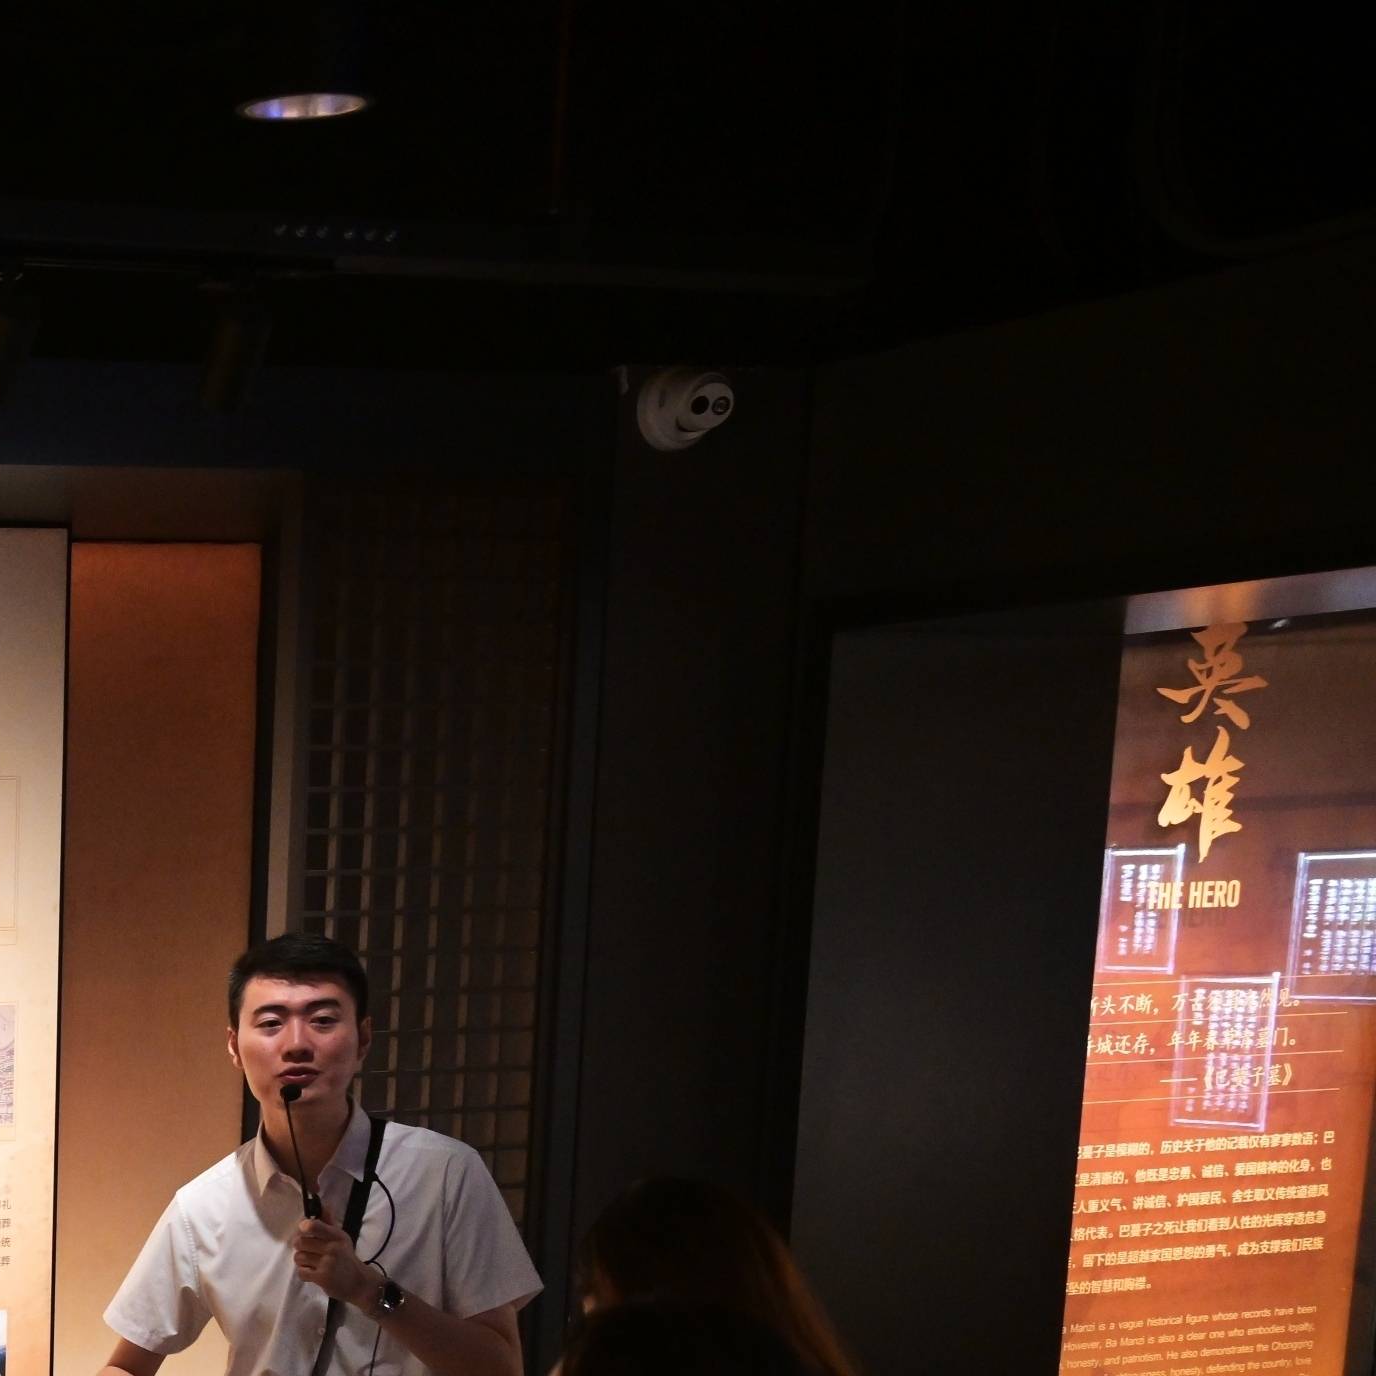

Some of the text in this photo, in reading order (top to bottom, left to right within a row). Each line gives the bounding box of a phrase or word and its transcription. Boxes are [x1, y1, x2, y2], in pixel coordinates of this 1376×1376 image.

[1156, 622, 1268, 864] 英雄
[1147, 880, 1241, 910] THE HERO
[1075, 1157, 1332, 1187] 是清晰的，他既是忠勇、诚信、爱国精神的化身，也
[1073, 1184, 1329, 1214] 人重义气、讲诚信、护国爱民、舍生取义传统道德风
[1070, 1210, 1327, 1241] 格代表。巴蔓子之死让我们看到人性的光辉穿透危急
[1118, 1319, 1144, 1331] vague
[1147, 1316, 1183, 1327] historical
[1186, 1314, 1209, 1326] figure
[1212, 1311, 1238, 1321] whose
[1241, 1309, 1271, 1319] records
[1274, 1307, 1294, 1316] have
[1297, 1305, 1317, 1314] been
[1158, 1334, 1176, 1343] also
[1209, 1330, 1225, 1339] one
[1228, 1327, 1244, 1337] who
[1104, 1355, 1120, 1366] and
[1167, 1350, 1179, 1360] He
[1181, 1349, 1198, 1359] also
[1256, 1342, 1269, 1352] the
